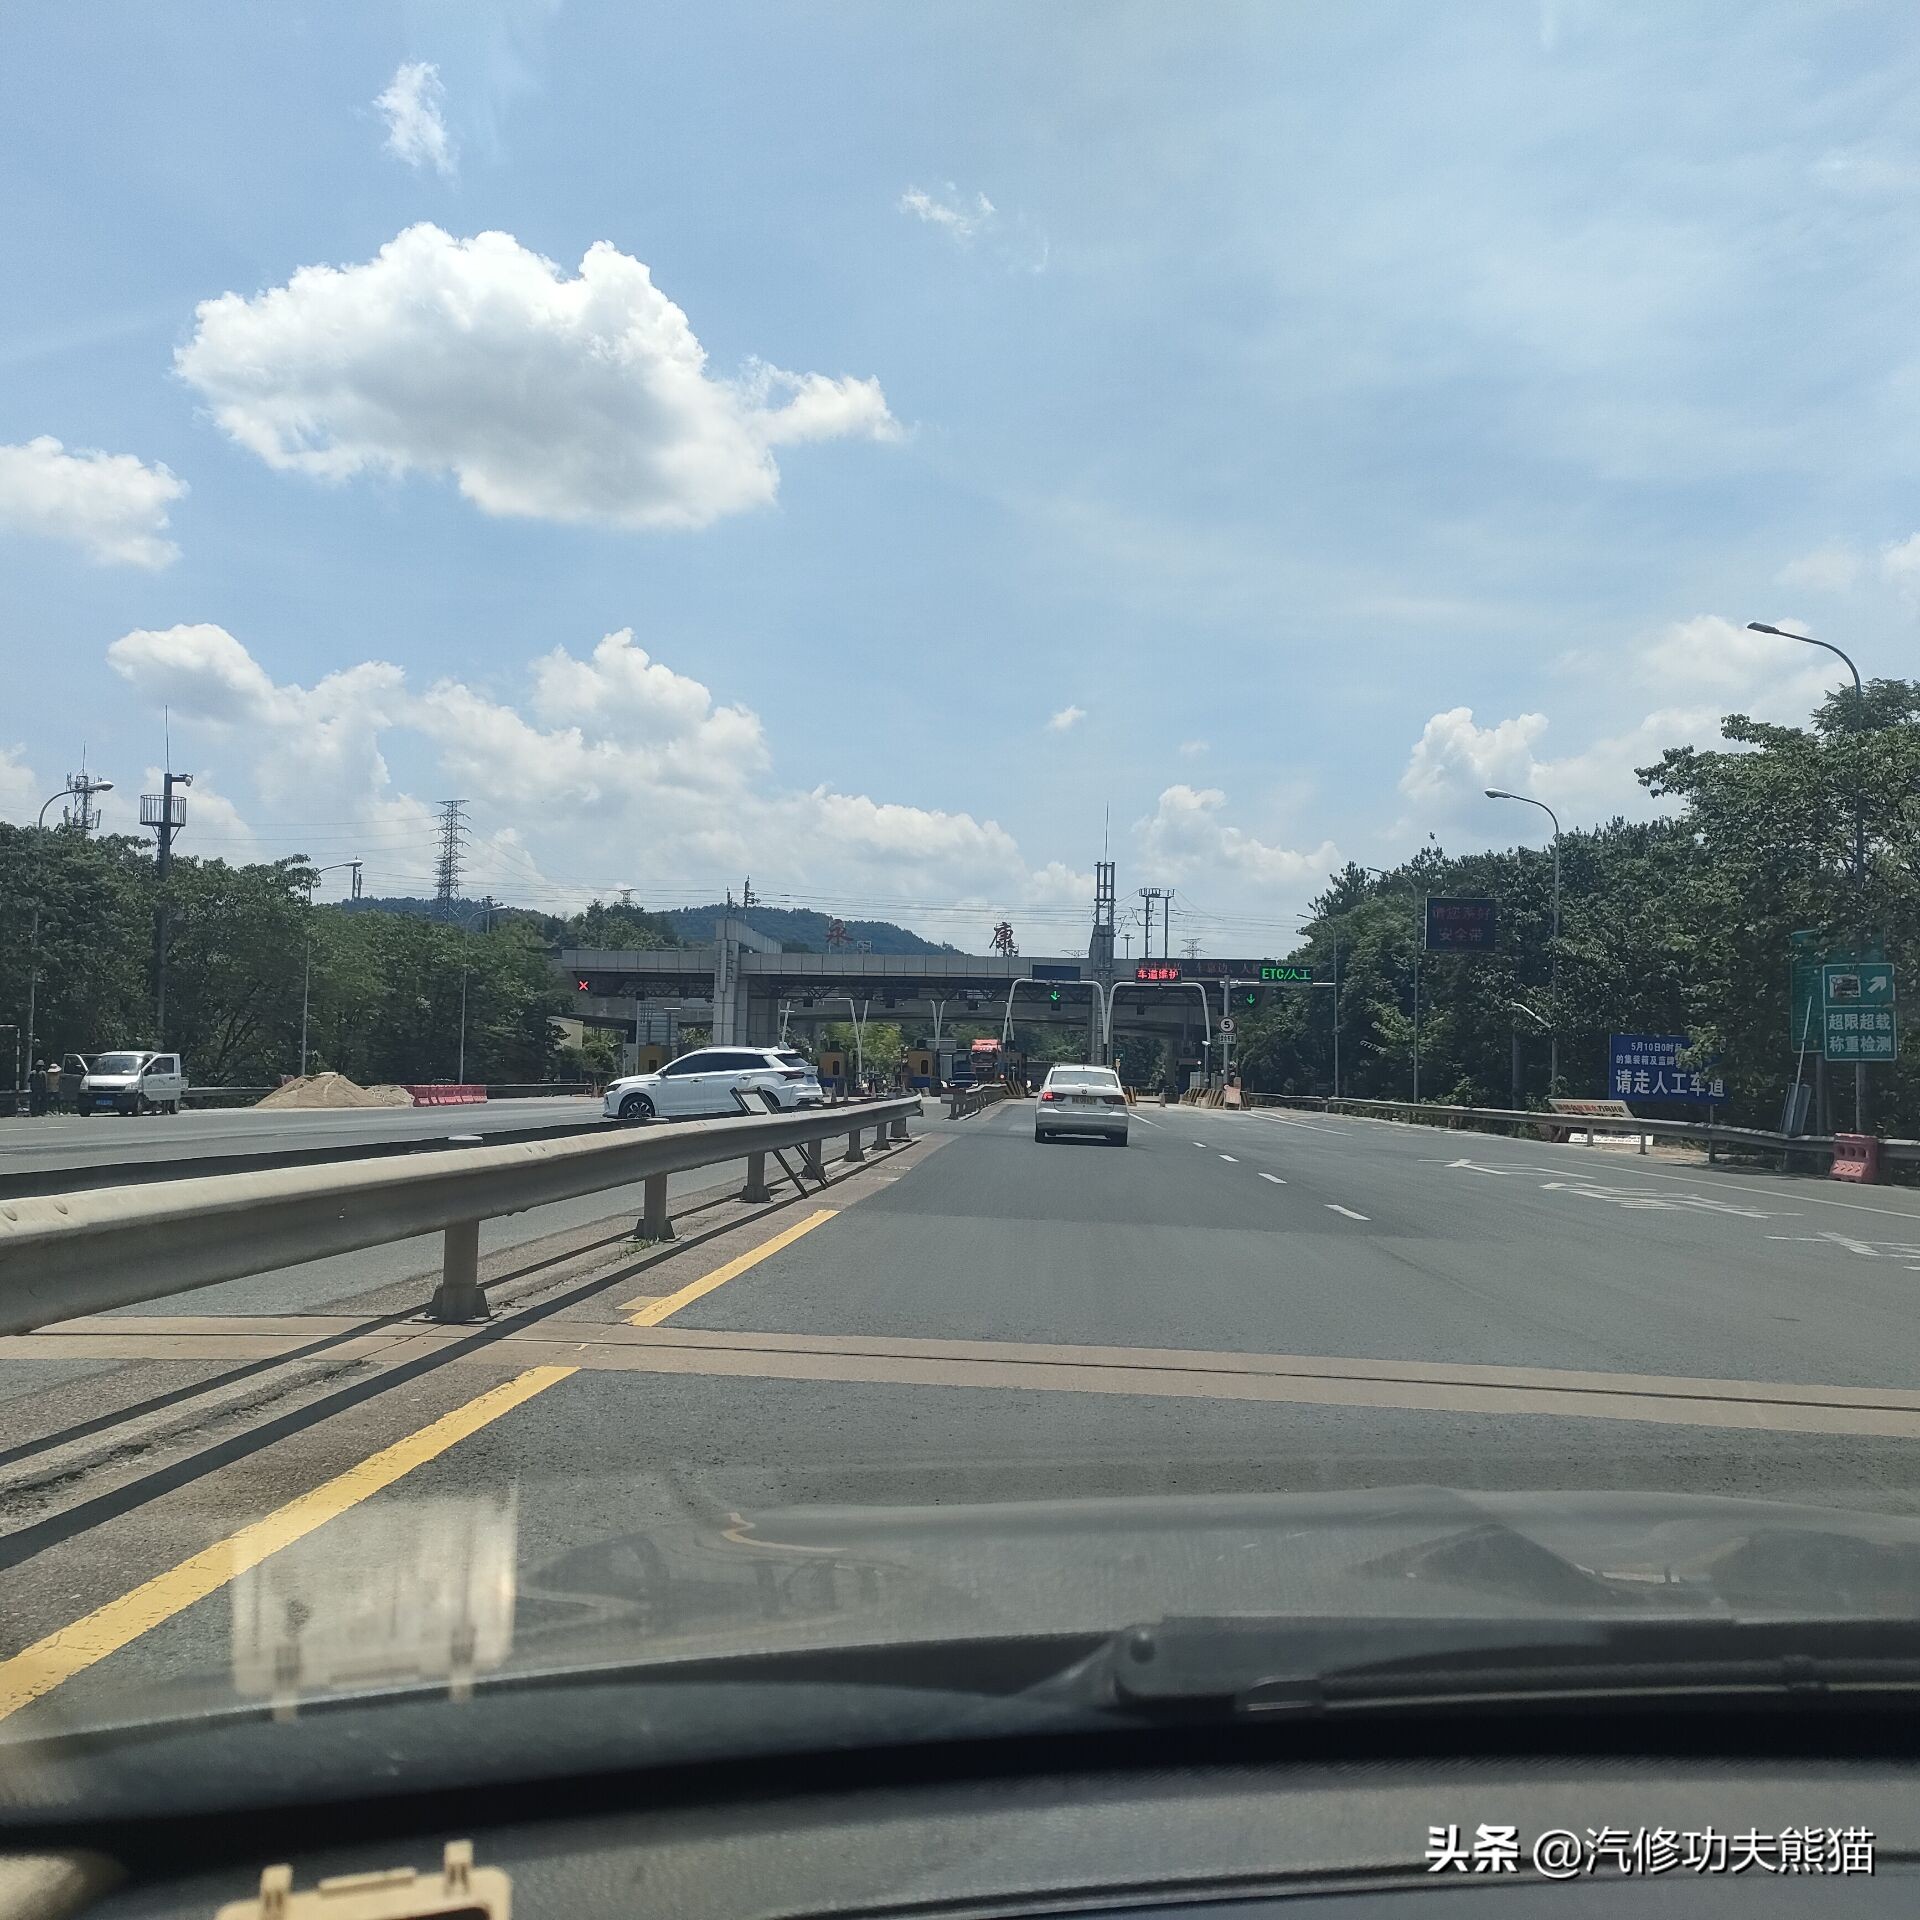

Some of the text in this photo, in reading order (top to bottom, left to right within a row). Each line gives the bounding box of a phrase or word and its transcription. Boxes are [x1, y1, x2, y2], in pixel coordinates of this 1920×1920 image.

[988, 921, 1019, 957] 康
[1439, 927, 1484, 941] 安全带
[1137, 968, 1179, 980] 车道维护
[1261, 968, 1312, 981] ETC/人工
[1223, 1020, 1231, 1029] 5
[1828, 1013, 1891, 1031] 超限超载
[1829, 1035, 1892, 1052] 称重检测
[1615, 1069, 1725, 1097] 请走人工车道
